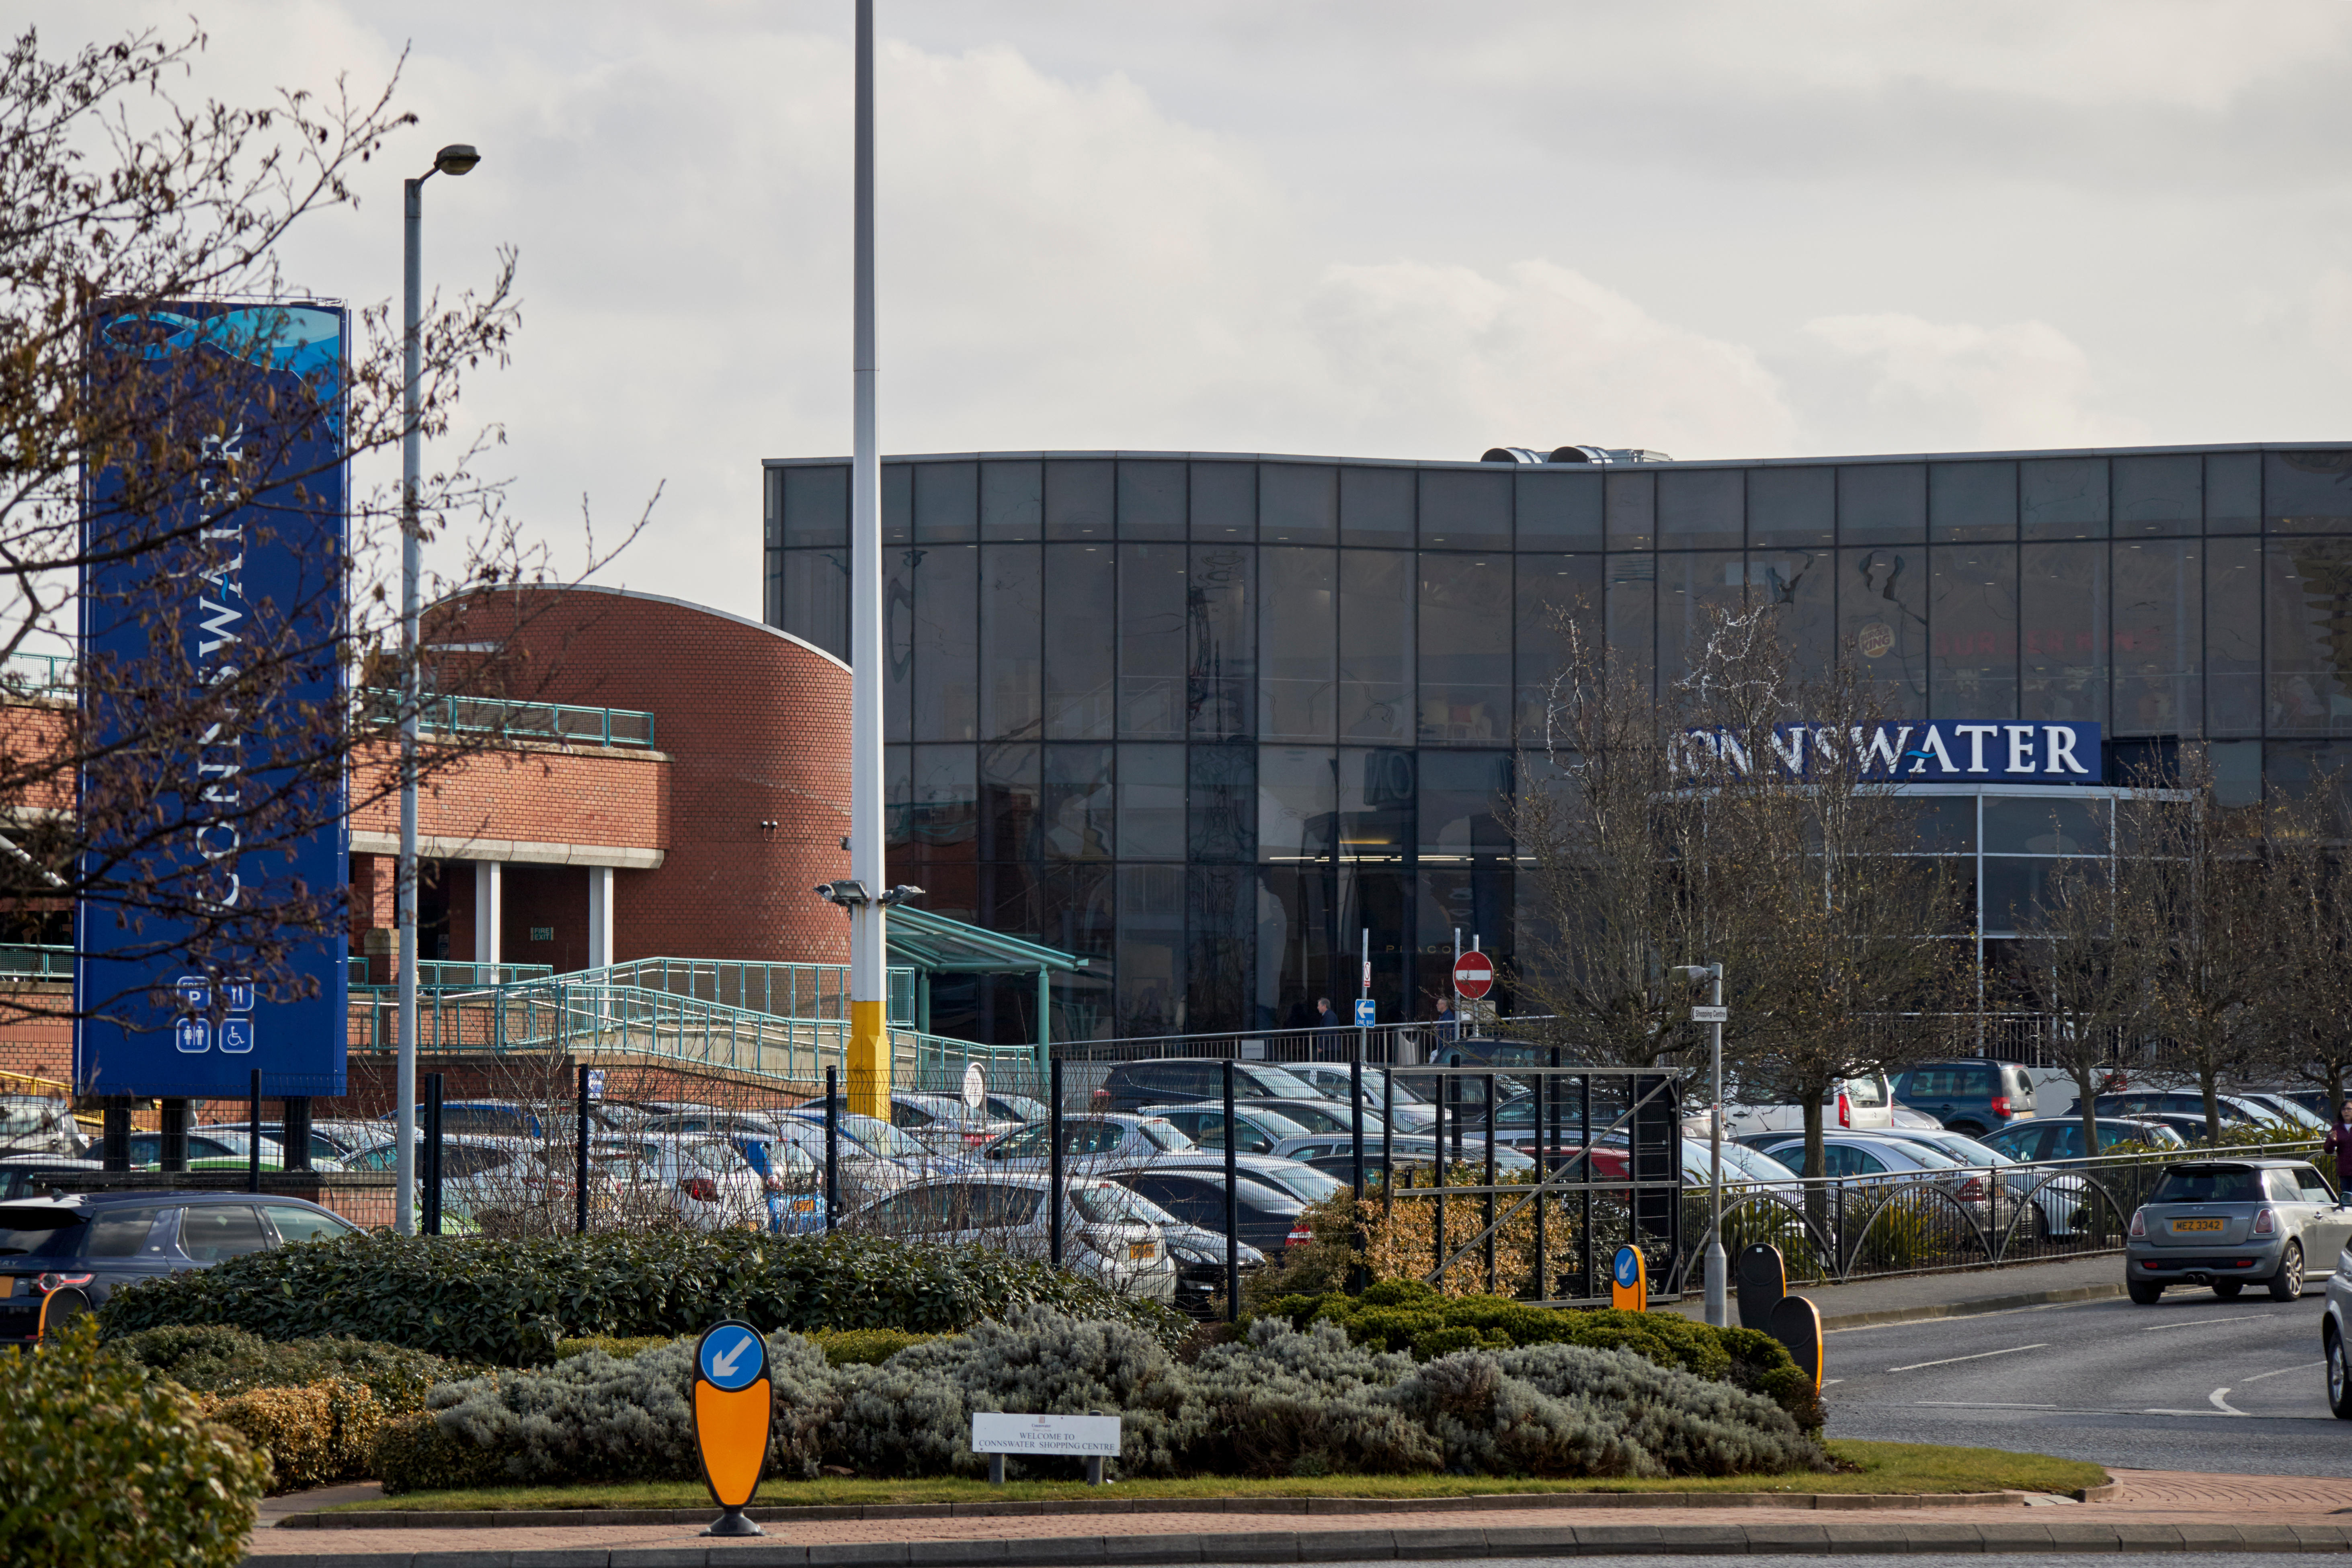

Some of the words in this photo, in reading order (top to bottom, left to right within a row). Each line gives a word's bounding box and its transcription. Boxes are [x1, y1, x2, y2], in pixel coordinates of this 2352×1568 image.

[1860, 628, 1890, 643] BURGER
[1861, 635, 1891, 653] KING
[197, 422, 242, 912] CONSWATER
[189, 991, 201, 1006] P
[1696, 1010, 1712, 1019] Shopping
[2176, 1222, 2194, 1230] MEZ
[2196, 1221, 2220, 1230] 3342
[1019, 1432, 1062, 1440] WELCOME
[979, 1440, 1035, 1448] CONNSWATER
[1039, 1441, 1080, 1449] SHOPPING
